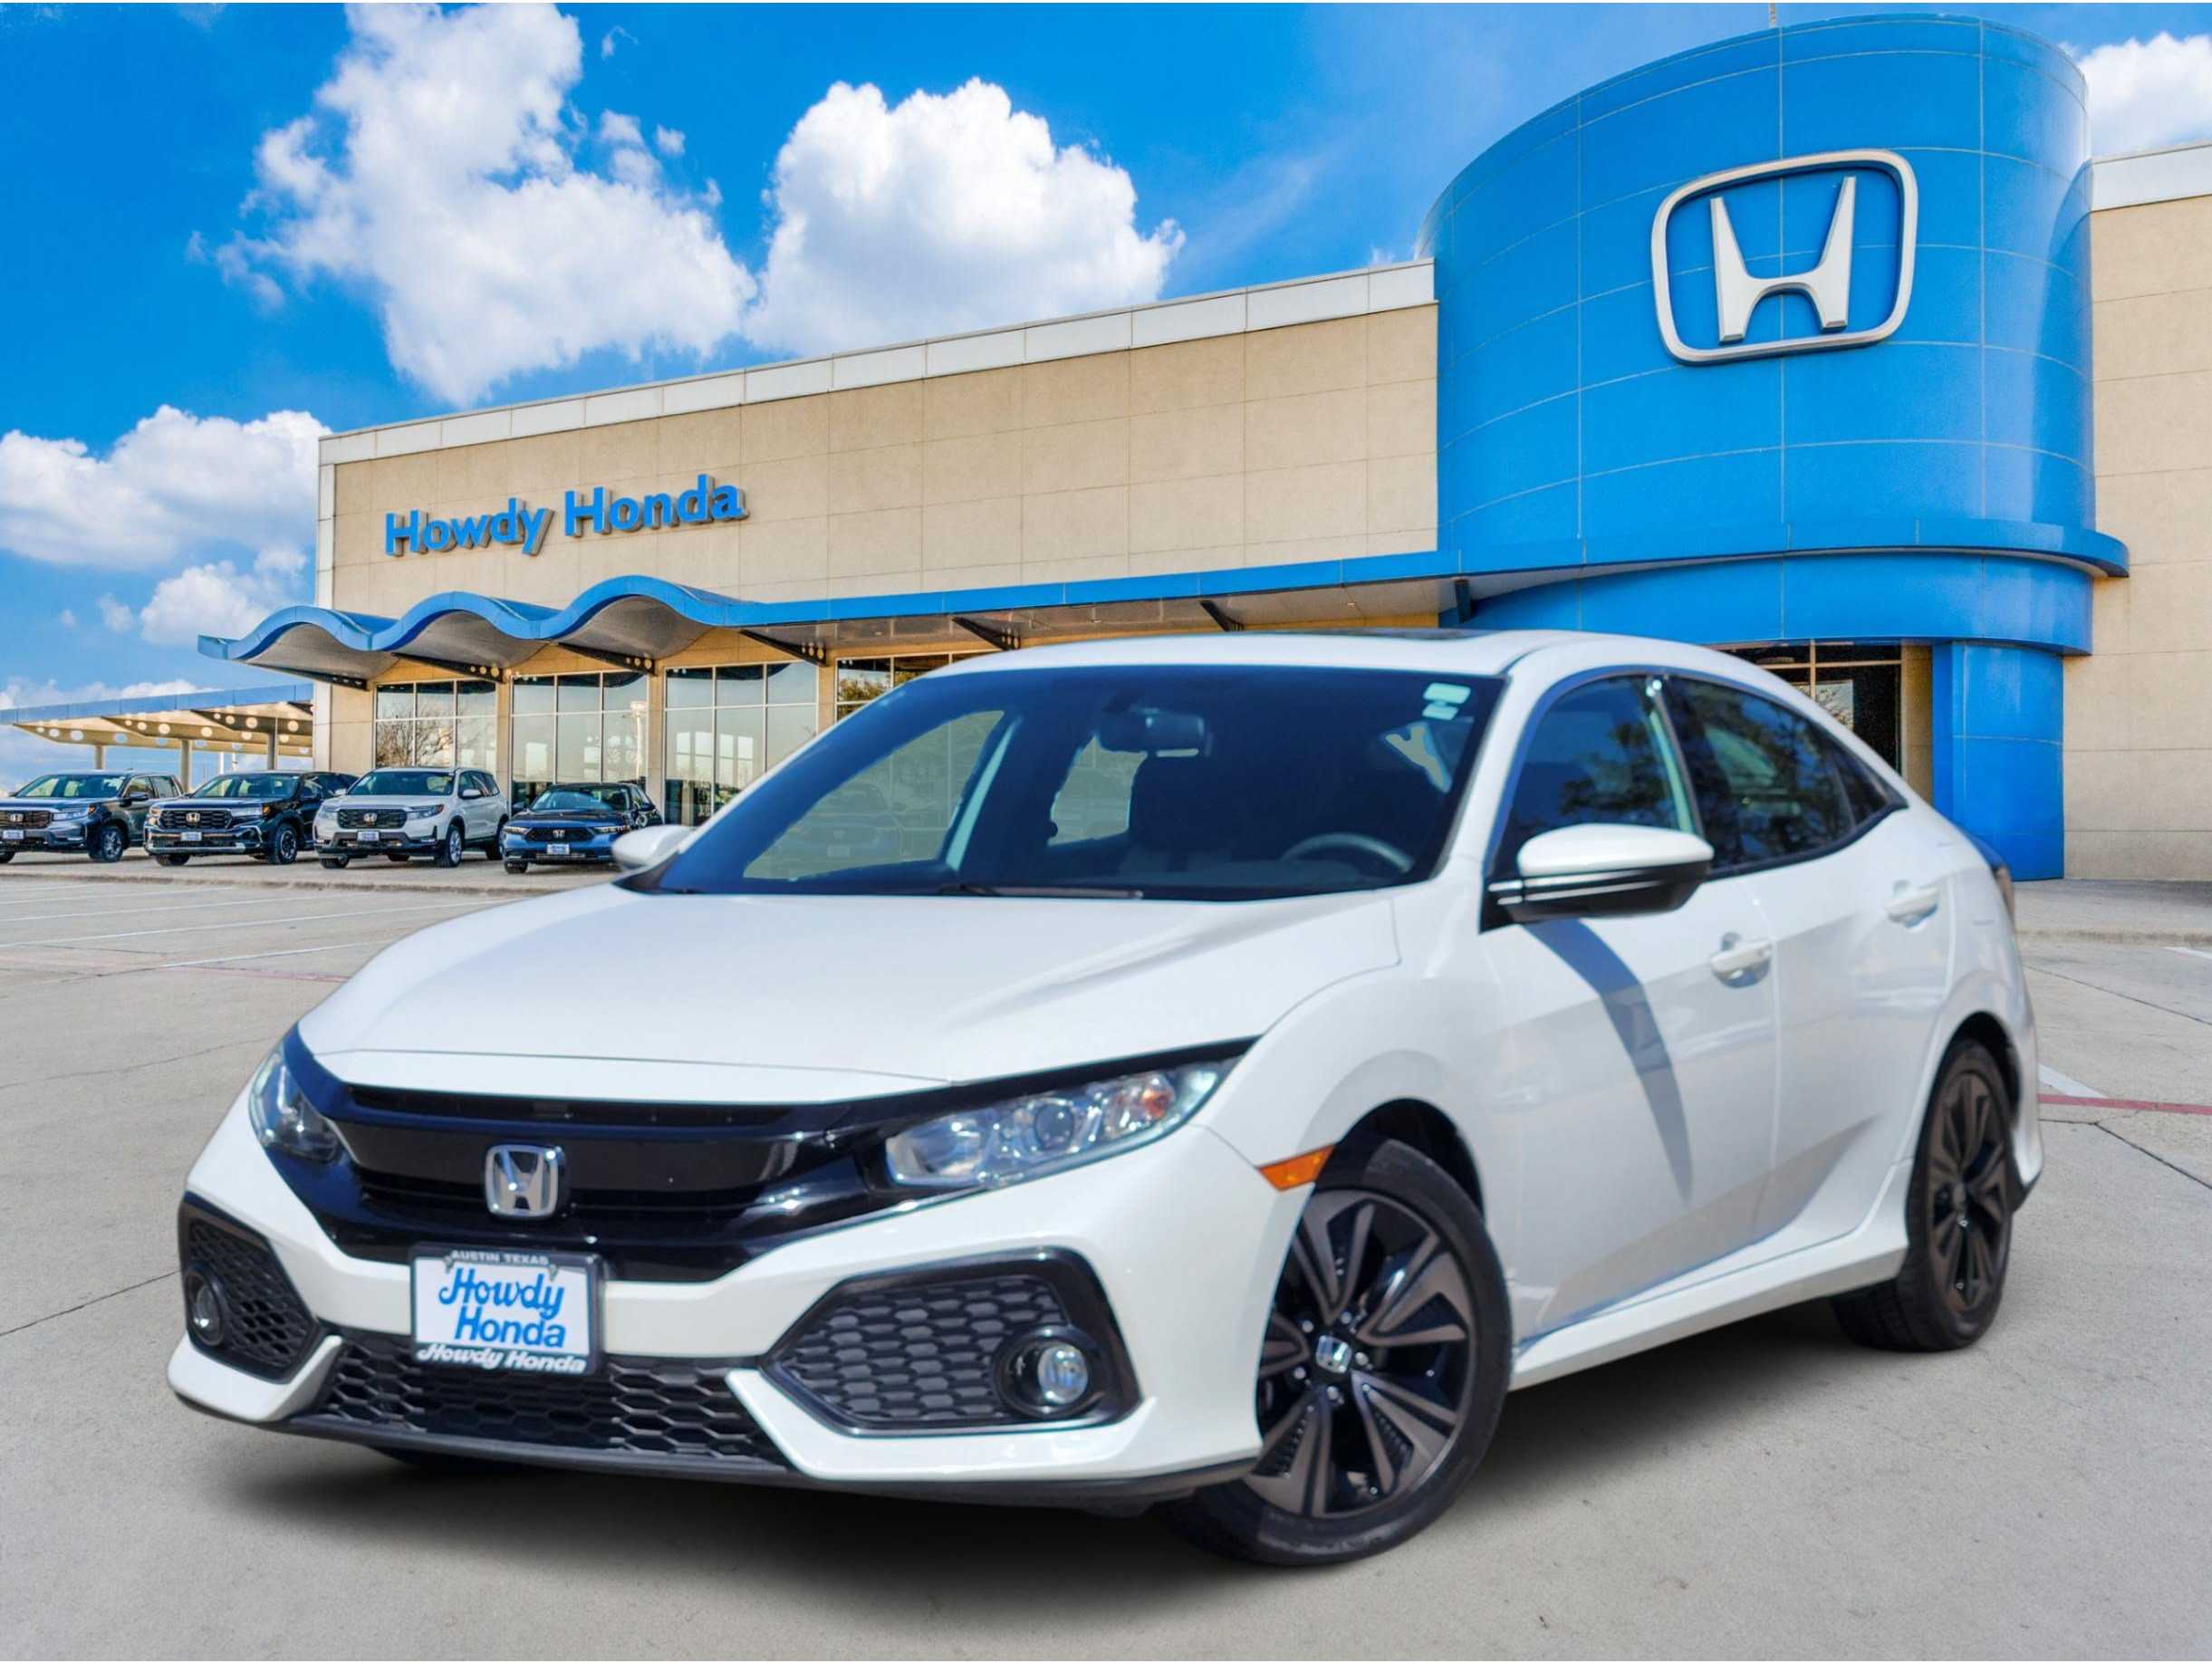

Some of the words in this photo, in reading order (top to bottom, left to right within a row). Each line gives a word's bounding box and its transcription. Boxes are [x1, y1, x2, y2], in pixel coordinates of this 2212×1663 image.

[385, 497, 553, 555] Howdy
[564, 474, 748, 537] Honda
[451, 1250, 500, 1262] AUSTIN
[503, 1253, 549, 1265] TEXAS
[438, 1268, 564, 1321] Howdy
[454, 1305, 566, 1348] Honda
[417, 1342, 505, 1370] Howdy
[504, 1351, 587, 1374] Honda
